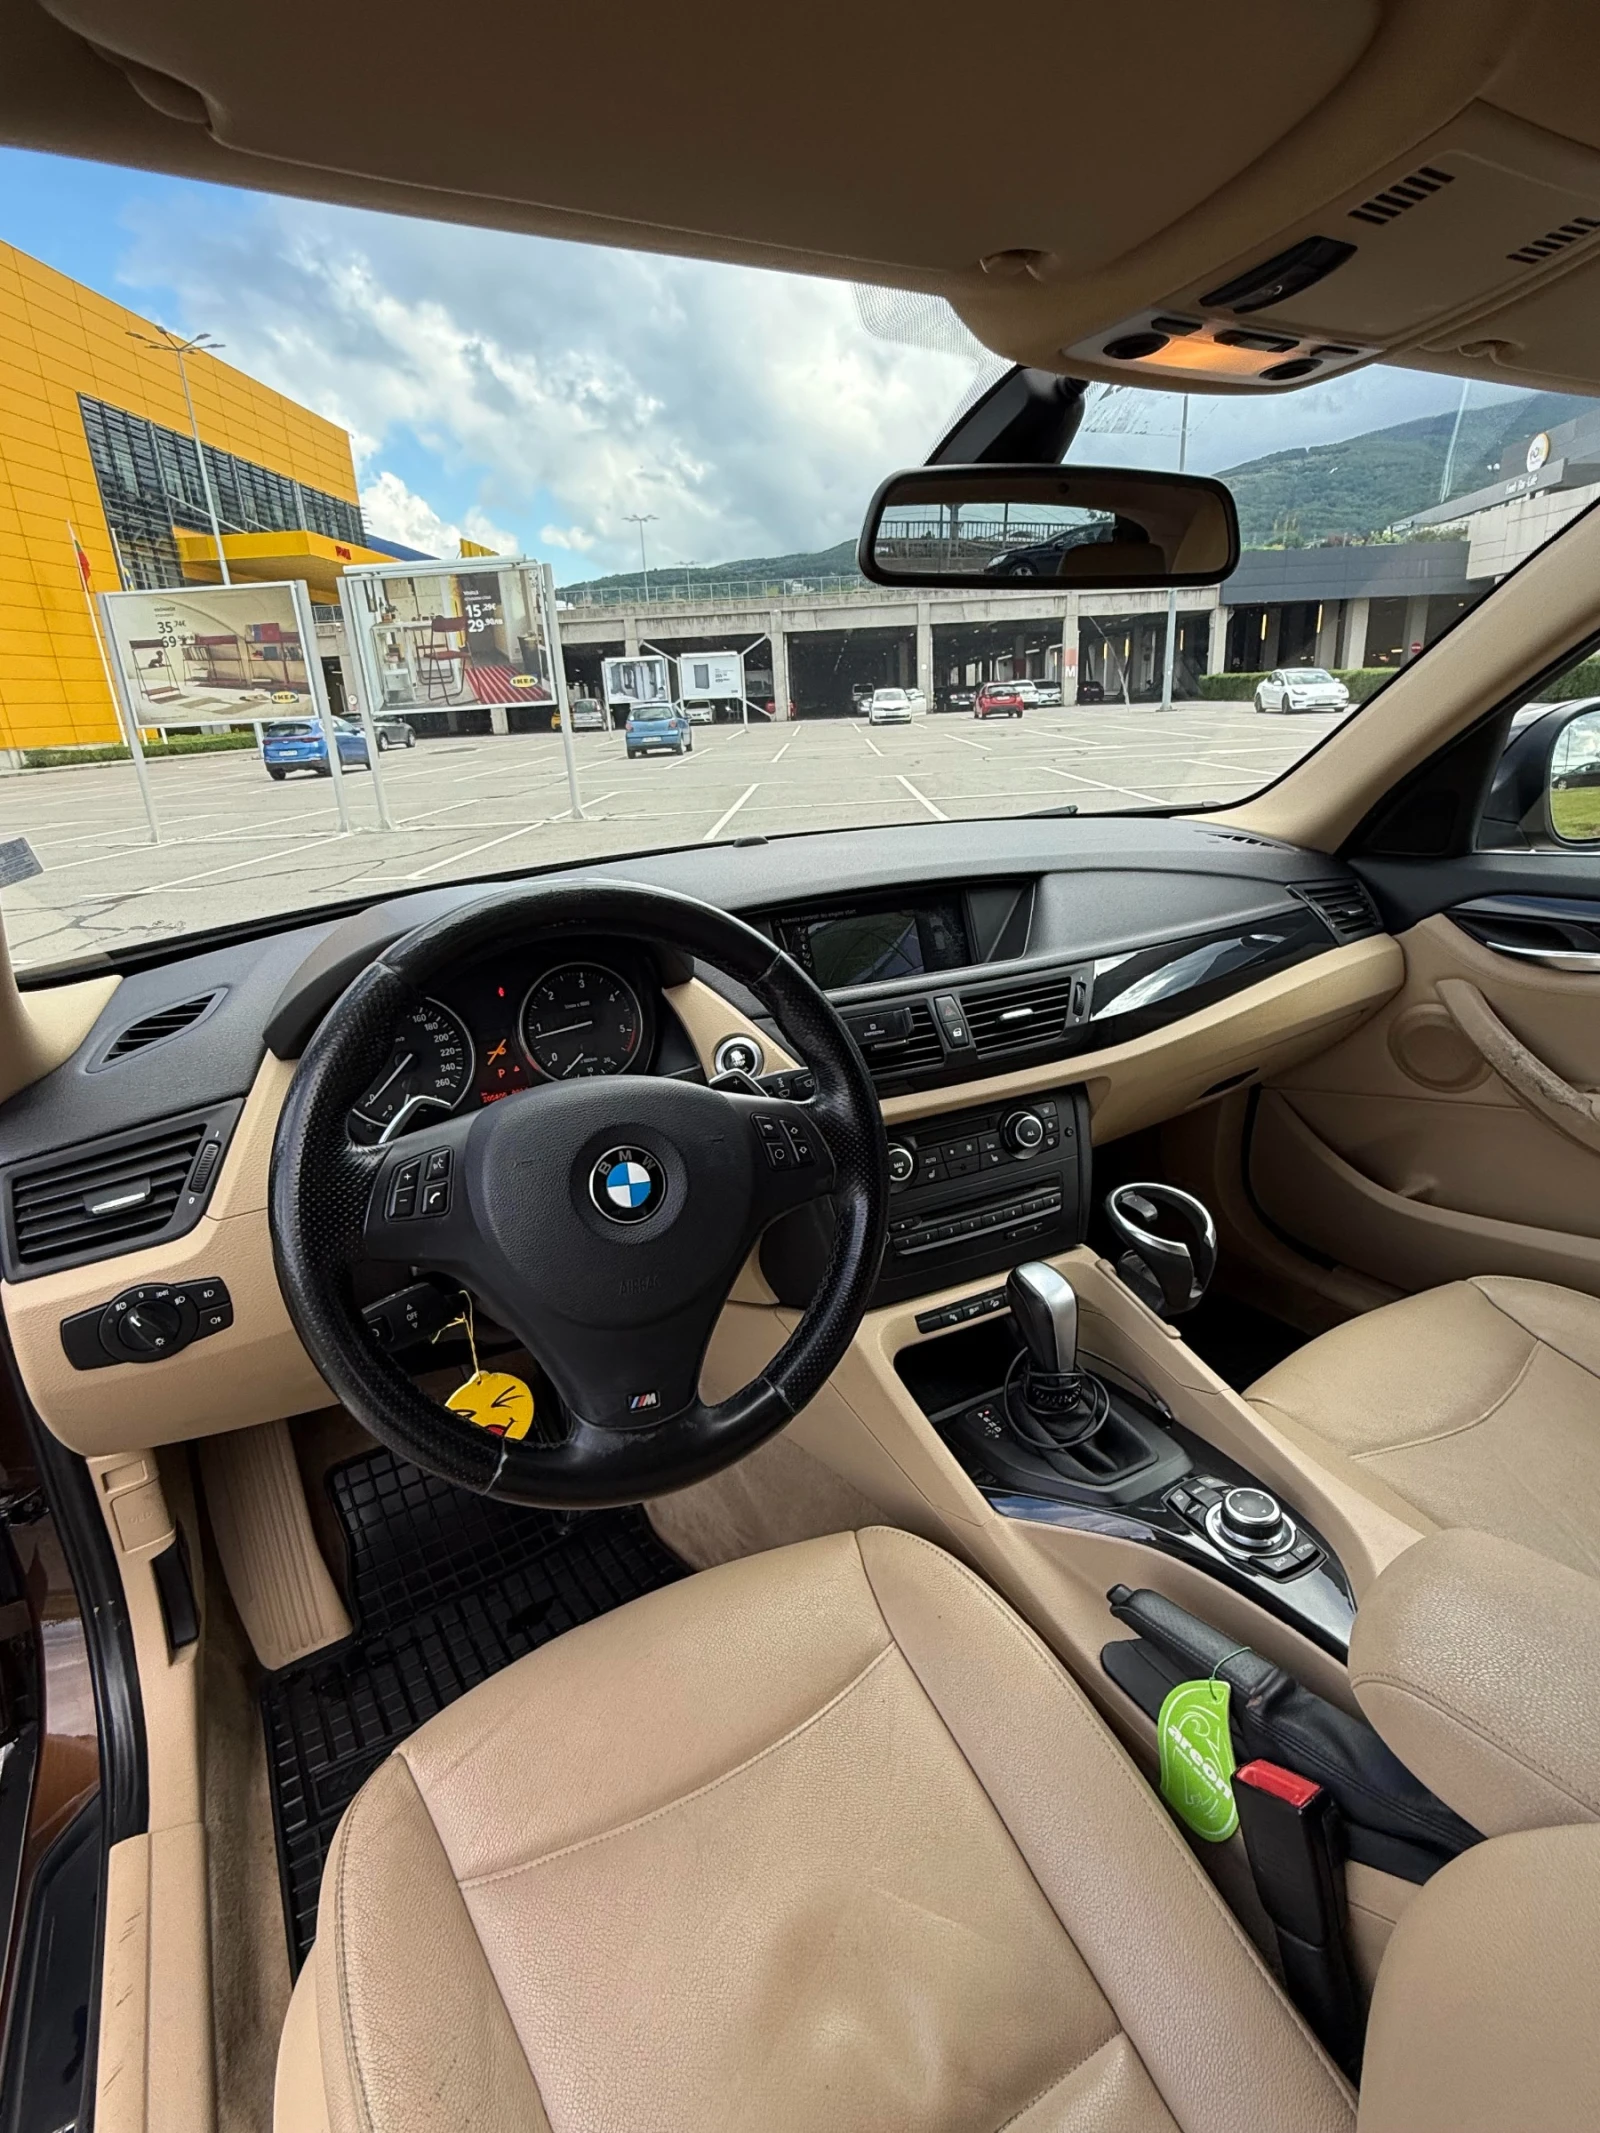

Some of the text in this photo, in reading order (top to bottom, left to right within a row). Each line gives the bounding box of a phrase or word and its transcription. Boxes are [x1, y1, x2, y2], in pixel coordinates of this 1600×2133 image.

[1065, 665, 1076, 677] M
[579, 979, 586, 989] 3
[547, 991, 554, 1001] 2
[609, 993, 616, 1003] 4
[412, 1013, 427, 1023] 160
[424, 1022, 439, 1032] 180
[619, 1024, 626, 1033] 5
[433, 1033, 449, 1043] 200
[440, 1047, 456, 1057] 220
[551, 1052, 558, 1062] 0
[440, 1062, 456, 1073] 240
[498, 1069, 506, 1078] P
[434, 1078, 451, 1088] 260
[598, 1149, 657, 1176] BMW
[1167, 1725, 1233, 1800] areon
